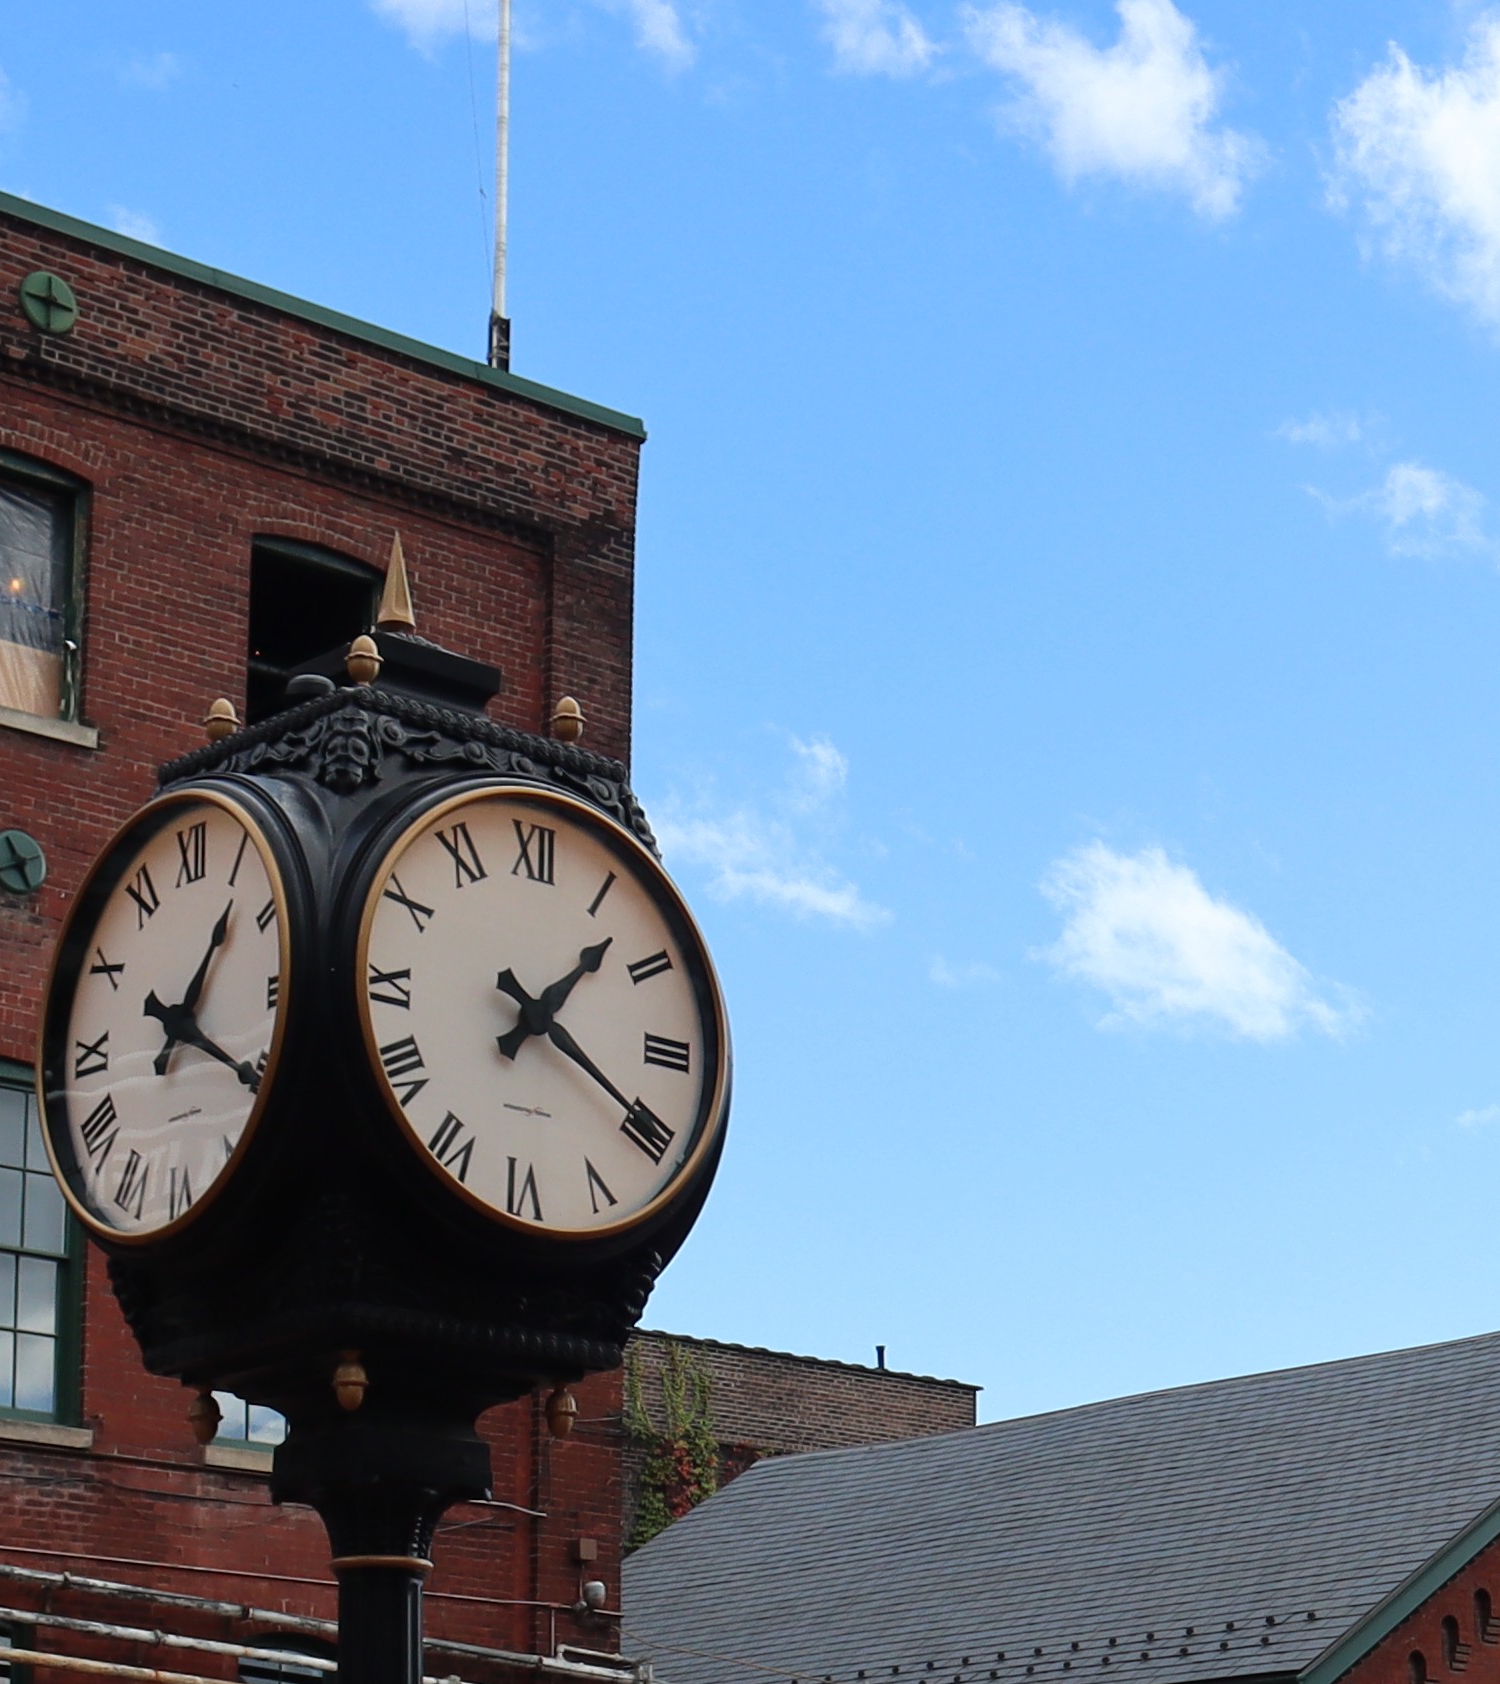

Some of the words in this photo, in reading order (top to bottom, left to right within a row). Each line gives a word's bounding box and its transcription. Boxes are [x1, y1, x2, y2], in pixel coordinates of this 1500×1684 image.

[176, 821, 206, 888] XII
[434, 822, 488, 889] XI
[511, 818, 556, 886] XII
[125, 862, 161, 931] XI
[383, 872, 435, 934] X
[89, 948, 126, 991] X
[368, 962, 411, 1010] IX
[627, 949, 674, 985] II
[74, 1030, 109, 1080] IX
[644, 1031, 690, 1074] III
[506, 1156, 544, 1222] VI
[584, 1155, 618, 1214] V
